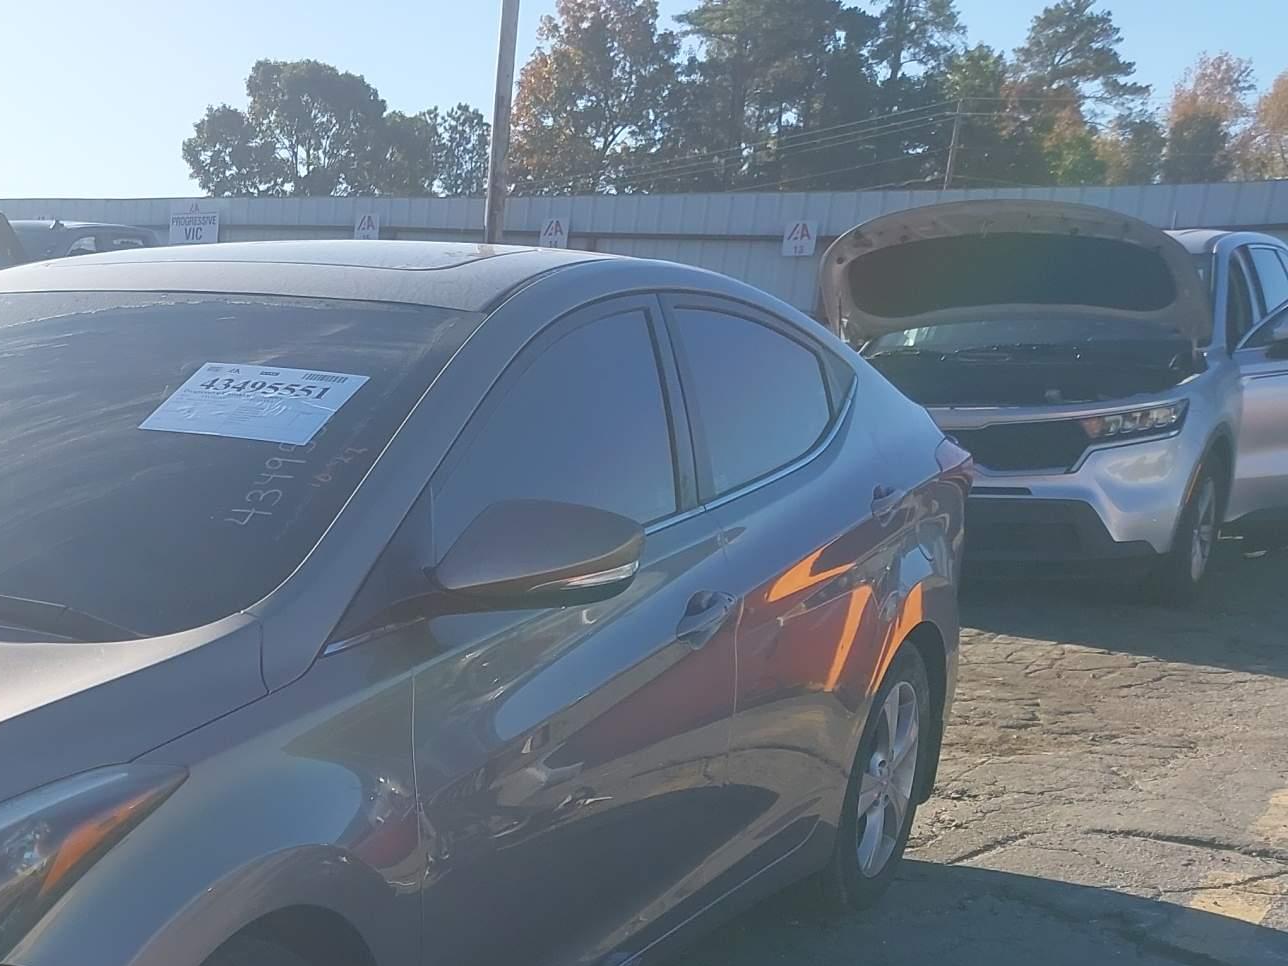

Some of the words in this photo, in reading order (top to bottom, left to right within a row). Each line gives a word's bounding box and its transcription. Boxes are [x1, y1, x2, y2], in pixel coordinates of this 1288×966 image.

[171, 216, 217, 226] PROGRESSIVE
[184, 227, 203, 241] VIC
[200, 377, 332, 400] 43495551
